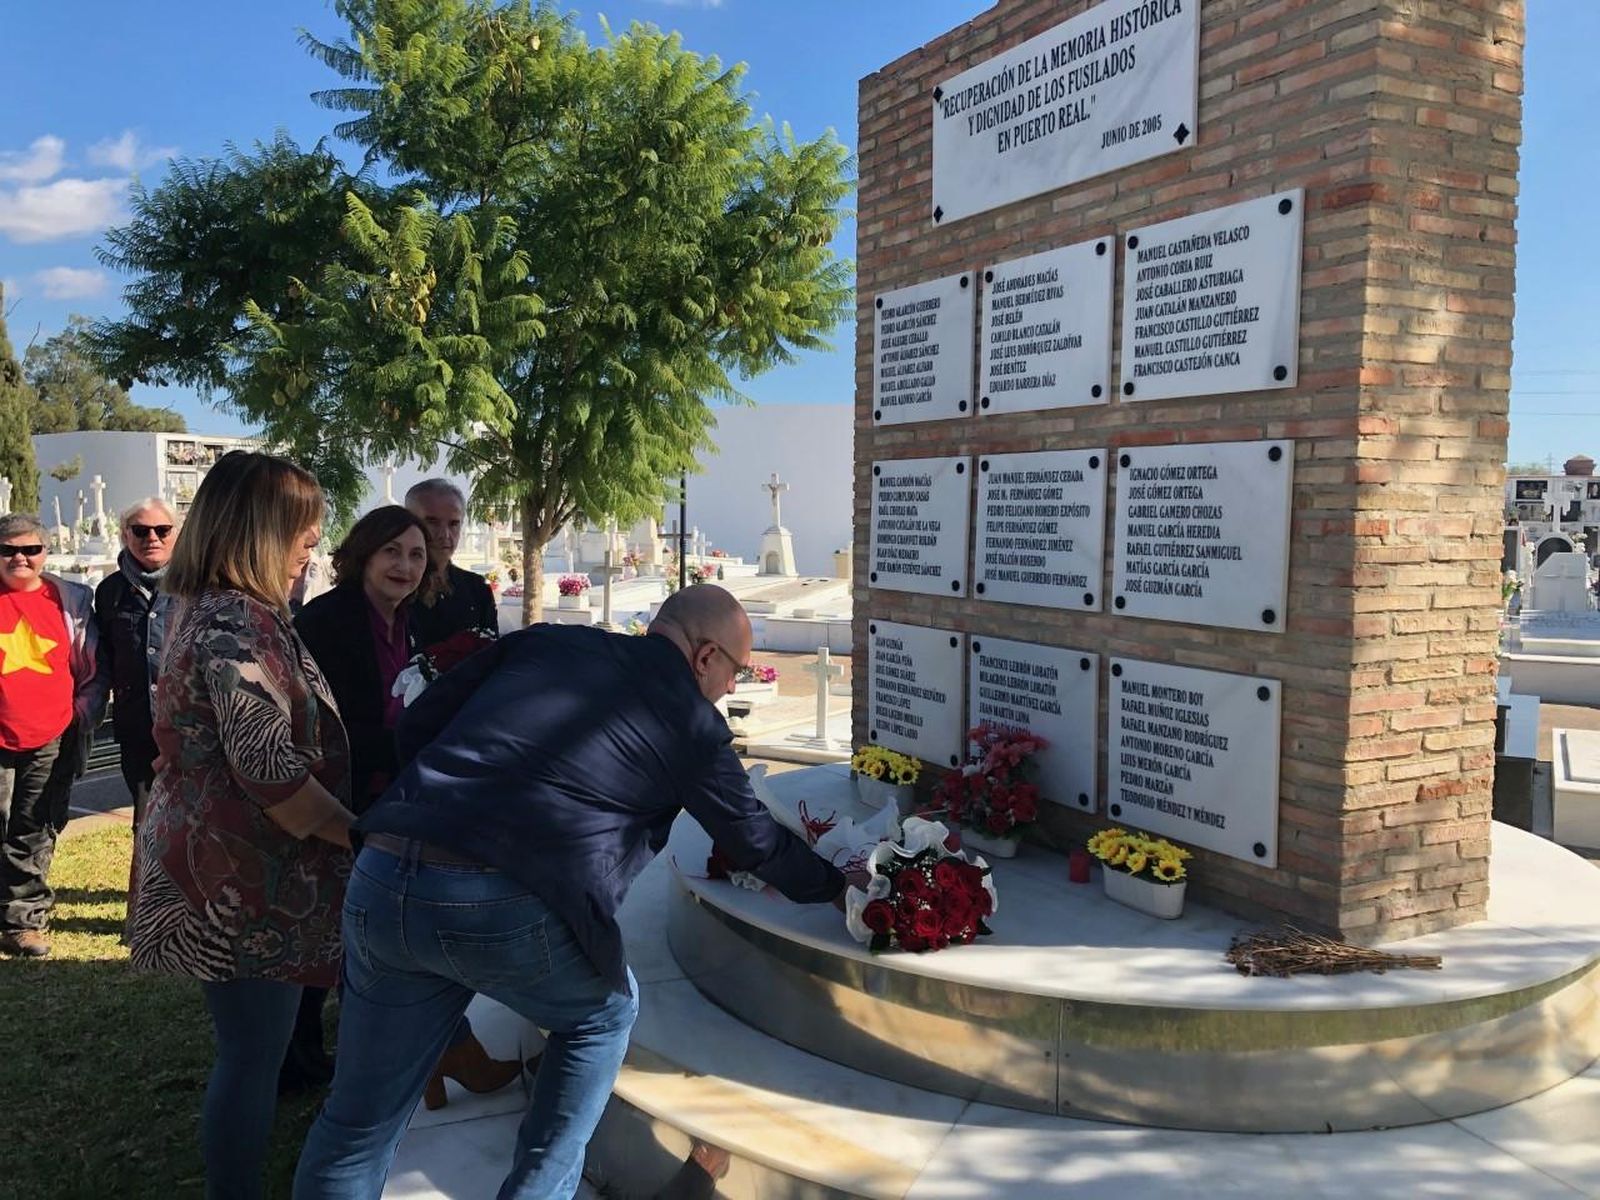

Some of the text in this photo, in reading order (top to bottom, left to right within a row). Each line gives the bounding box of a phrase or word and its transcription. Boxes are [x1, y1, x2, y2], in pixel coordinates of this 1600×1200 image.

[940, 0, 1181, 118] "RECUPERACIÓN DE LA MEMORIA HISTÓRICA
[968, 45, 1135, 136] Y DIGNIDAD DE LOS FUSILADOS
[999, 95, 1096, 153] EN PUERTO REAL."
[1101, 114, 1162, 149] JUNIO DE 2005
[1137, 225, 1249, 263] MANUEL CASTAÑEDA VELASCO
[1136, 263, 1168, 282] ANTONIO
[1194, 253, 1212, 271] RUIZ
[991, 278, 1005, 295] JOSÉ
[1135, 267, 1244, 301] JOSÉ CABALLERO ASTURIAGA
[991, 295, 1013, 311] MANUEL
[1046, 284, 1064, 300] RIVAS
[1135, 289, 1236, 320] JUAN CATALÁN MANZANERO
[991, 308, 1023, 327] JOSÉ BELÉN
[1134, 306, 1259, 339] FRANCISCO CASTILLO GUTIÉRREZ
[990, 344, 1003, 360] JOSÉ
[1134, 329, 1247, 358] MANUEL CASTILLO GUTIÉRREZ
[989, 361, 1002, 376] JOSÉ
[1133, 351, 1240, 377] FRANCISCO CASTEJÓN CANCA
[987, 472, 1001, 484] JUAN
[1002, 472, 1024, 483] MANUEL
[1025, 468, 1059, 483] FERNÁNDEZ
[1129, 463, 1218, 481] IGNACIO GÓMEZ ORTEGA
[987, 485, 1000, 500] JOSÉ
[1009, 485, 1041, 500] FERNÁNDEZ
[1042, 485, 1063, 500] GÓMEZ
[1128, 483, 1203, 499] JOSÉ GÓMEZ ORTEGA
[986, 504, 1004, 516] PEDRO
[1005, 504, 1034, 516] FELICIANO
[1127, 505, 1222, 519] GABRIEL GAMERO CHOZAS
[986, 518, 1057, 534] FELIPE FERNÁNDEZ GÓMEZ
[1127, 521, 1221, 539] MANUEL GARCÍA HEREDIA
[985, 535, 1073, 552] FERNANDO FERNÁNDEZ JIMÉNEZ
[1126, 540, 1242, 560] RAFAEL GUTIÉRREZ SANMIGUEL
[984, 550, 997, 564] JOSÉ
[1125, 558, 1209, 578] MATÍAS GARCÍA GARCÍA
[984, 566, 1087, 588] JOSÉ MANUEL GUERRERO FERNÁNDEZ
[1125, 577, 1202, 598] JOSÉ GUZMÁN GARCÍA
[979, 655, 1007, 671] FRANCISCO
[979, 686, 1061, 714] GUILLERMO MARTÍNEZ GARCÍA
[1121, 679, 1150, 697] MANUEL
[1151, 684, 1186, 703] MONTERO
[1121, 698, 1146, 715] RAFAEL
[1174, 707, 1209, 727] IGLESIAS
[1121, 716, 1228, 751] RAFAEL MANZANO RODRÍGUEZ
[1120, 734, 1214, 767] ANTONIO MORENO GARCÍA
[1120, 752, 1136, 768] LUIS
[1163, 762, 1191, 781] GARCÍA
[1120, 770, 1173, 796] PEDRO MARZÁN
[1156, 797, 1186, 818] MÉNDEZ
[1187, 806, 1192, 820] Y
[1193, 806, 1225, 829] MÉNDEZ
